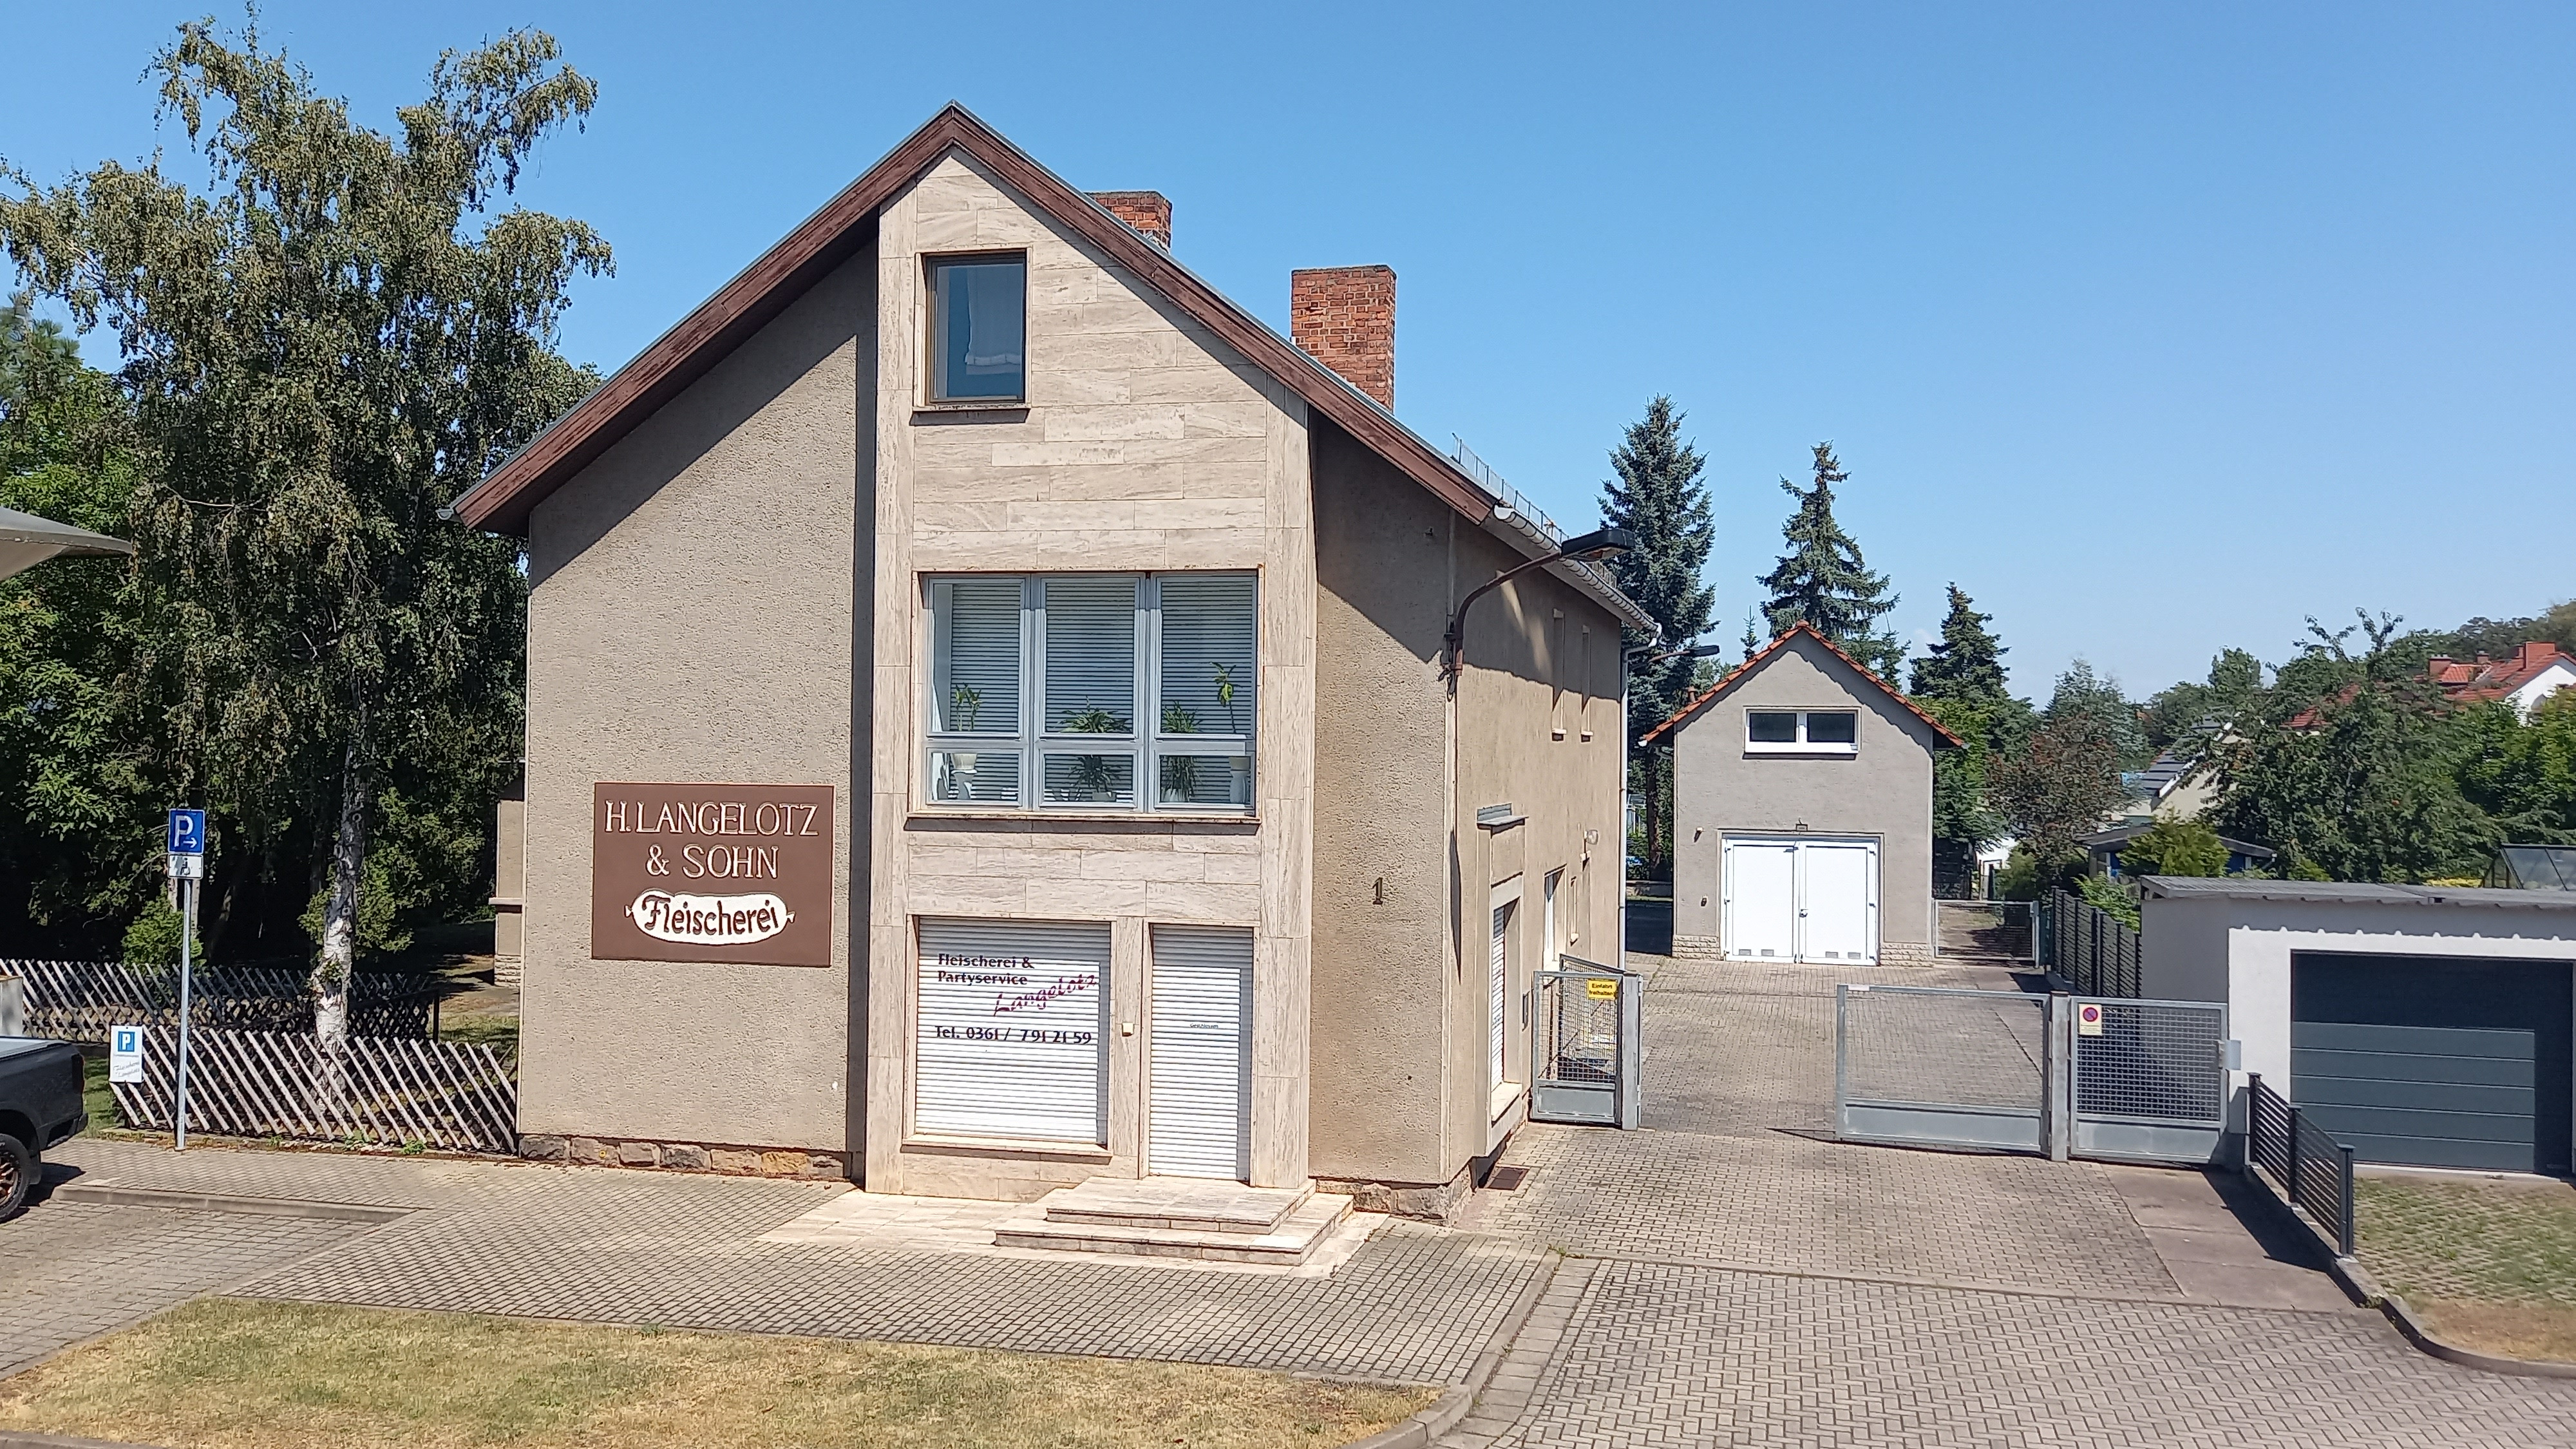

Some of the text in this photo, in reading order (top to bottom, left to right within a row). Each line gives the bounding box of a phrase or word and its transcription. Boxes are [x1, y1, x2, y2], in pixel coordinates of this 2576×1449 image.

[174, 815, 194, 848] P
[636, 802, 819, 835] LANGELOTZ
[646, 844, 779, 878] & SOHN
[1372, 876, 1383, 905] 1
[641, 894, 779, 936] Fleischerei
[938, 953, 1035, 969] Fleischerei &
[938, 971, 1028, 987] Partyservice
[122, 1033, 131, 1050] P
[935, 1026, 960, 1039] Tel.
[966, 1027, 998, 1040] 0361
[1020, 1029, 1046, 1043] 791
[1053, 1030, 1066, 1043] 21
[1074, 1031, 1092, 1045] 59
